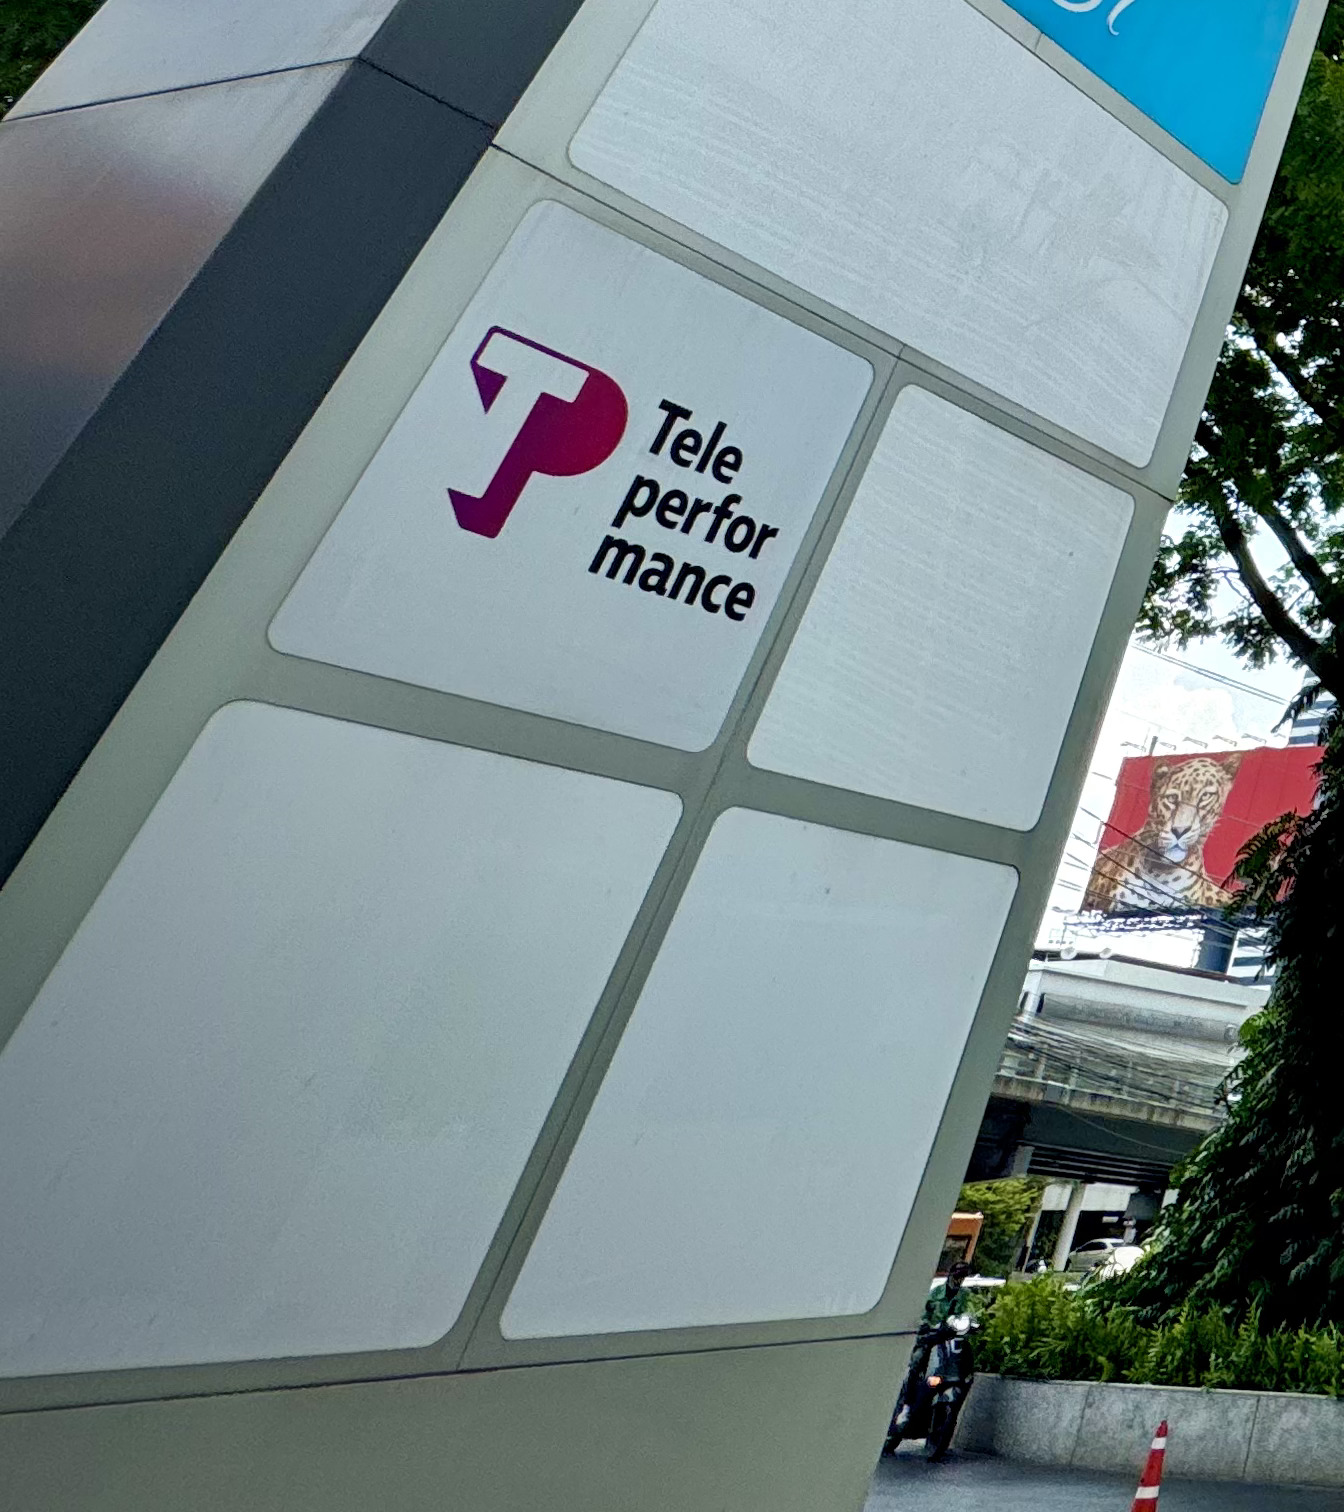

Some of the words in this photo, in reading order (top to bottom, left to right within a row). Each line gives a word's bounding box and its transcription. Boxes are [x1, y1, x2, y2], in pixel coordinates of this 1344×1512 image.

[649, 398, 743, 484] Tele
[611, 474, 779, 560] perfor
[588, 534, 756, 622] mance
